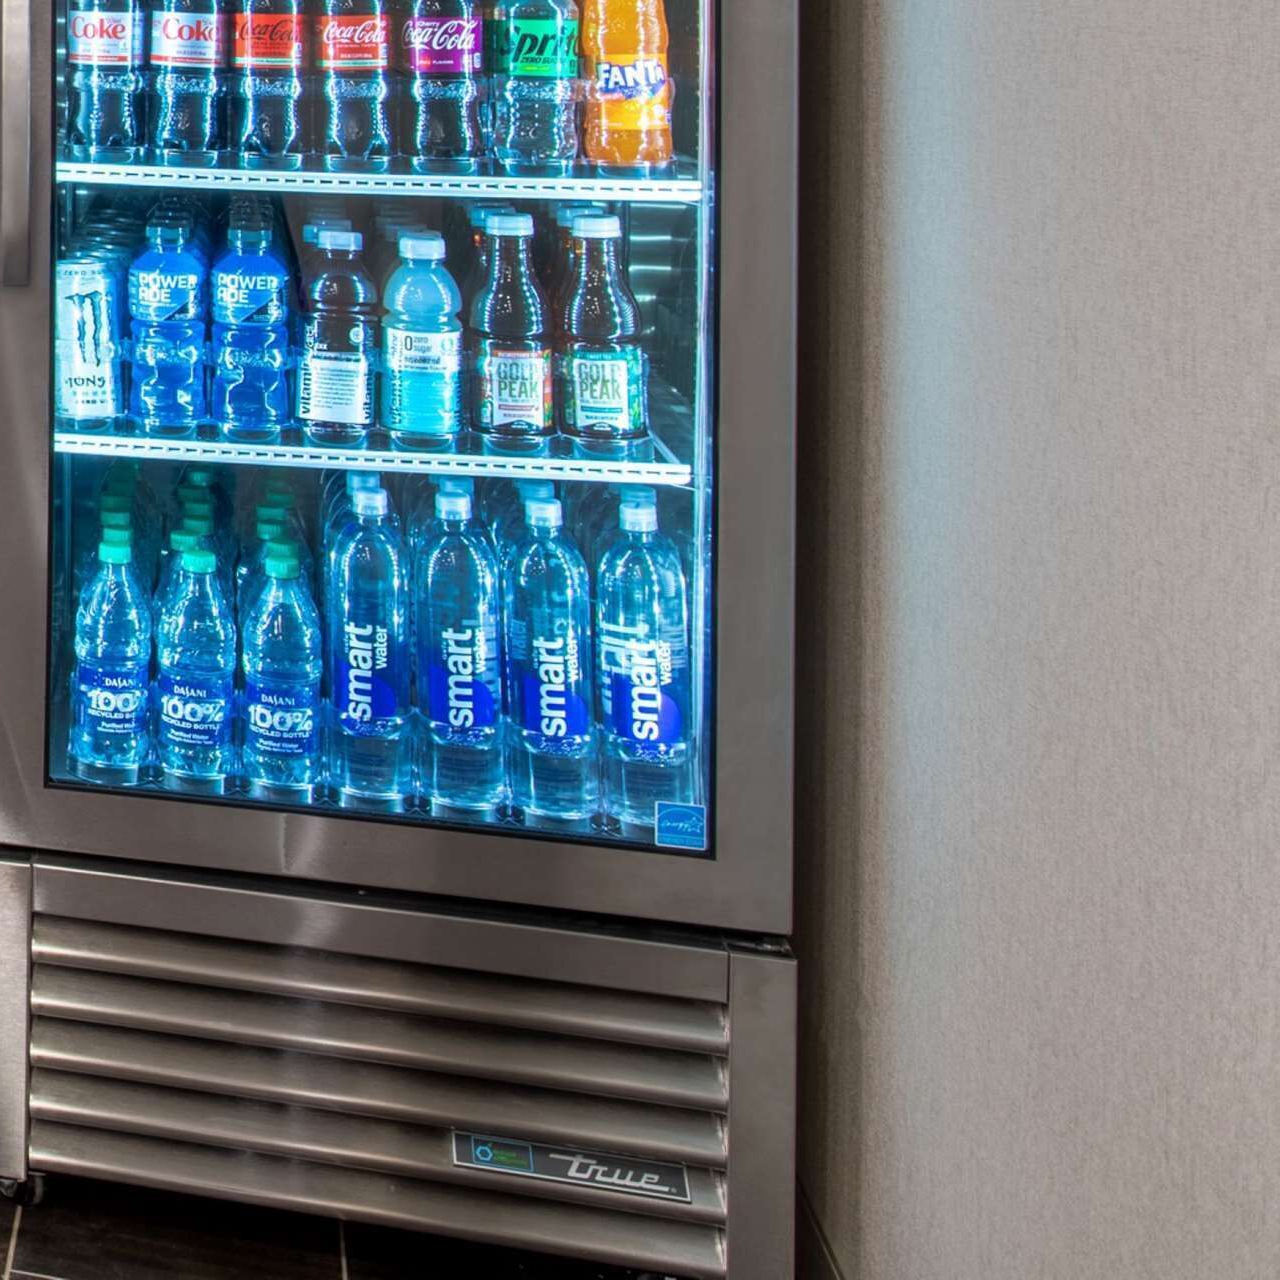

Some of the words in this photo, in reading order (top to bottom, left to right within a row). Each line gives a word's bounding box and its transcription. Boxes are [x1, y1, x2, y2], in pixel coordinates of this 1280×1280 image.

[71, 14, 126, 40] Coke
[323, 19, 386, 43] Coca-Cola
[401, 20, 477, 50] Coca-Cola
[344, 622, 373, 722] smart
[443, 627, 474, 730] smart
[173, 683, 207, 698] DASANI
[260, 693, 296, 706] DASANI
[533, 636, 566, 737] smart
[630, 640, 659, 741] smart
[160, 695, 226, 722] 100%
[247, 704, 314, 731] 100%
